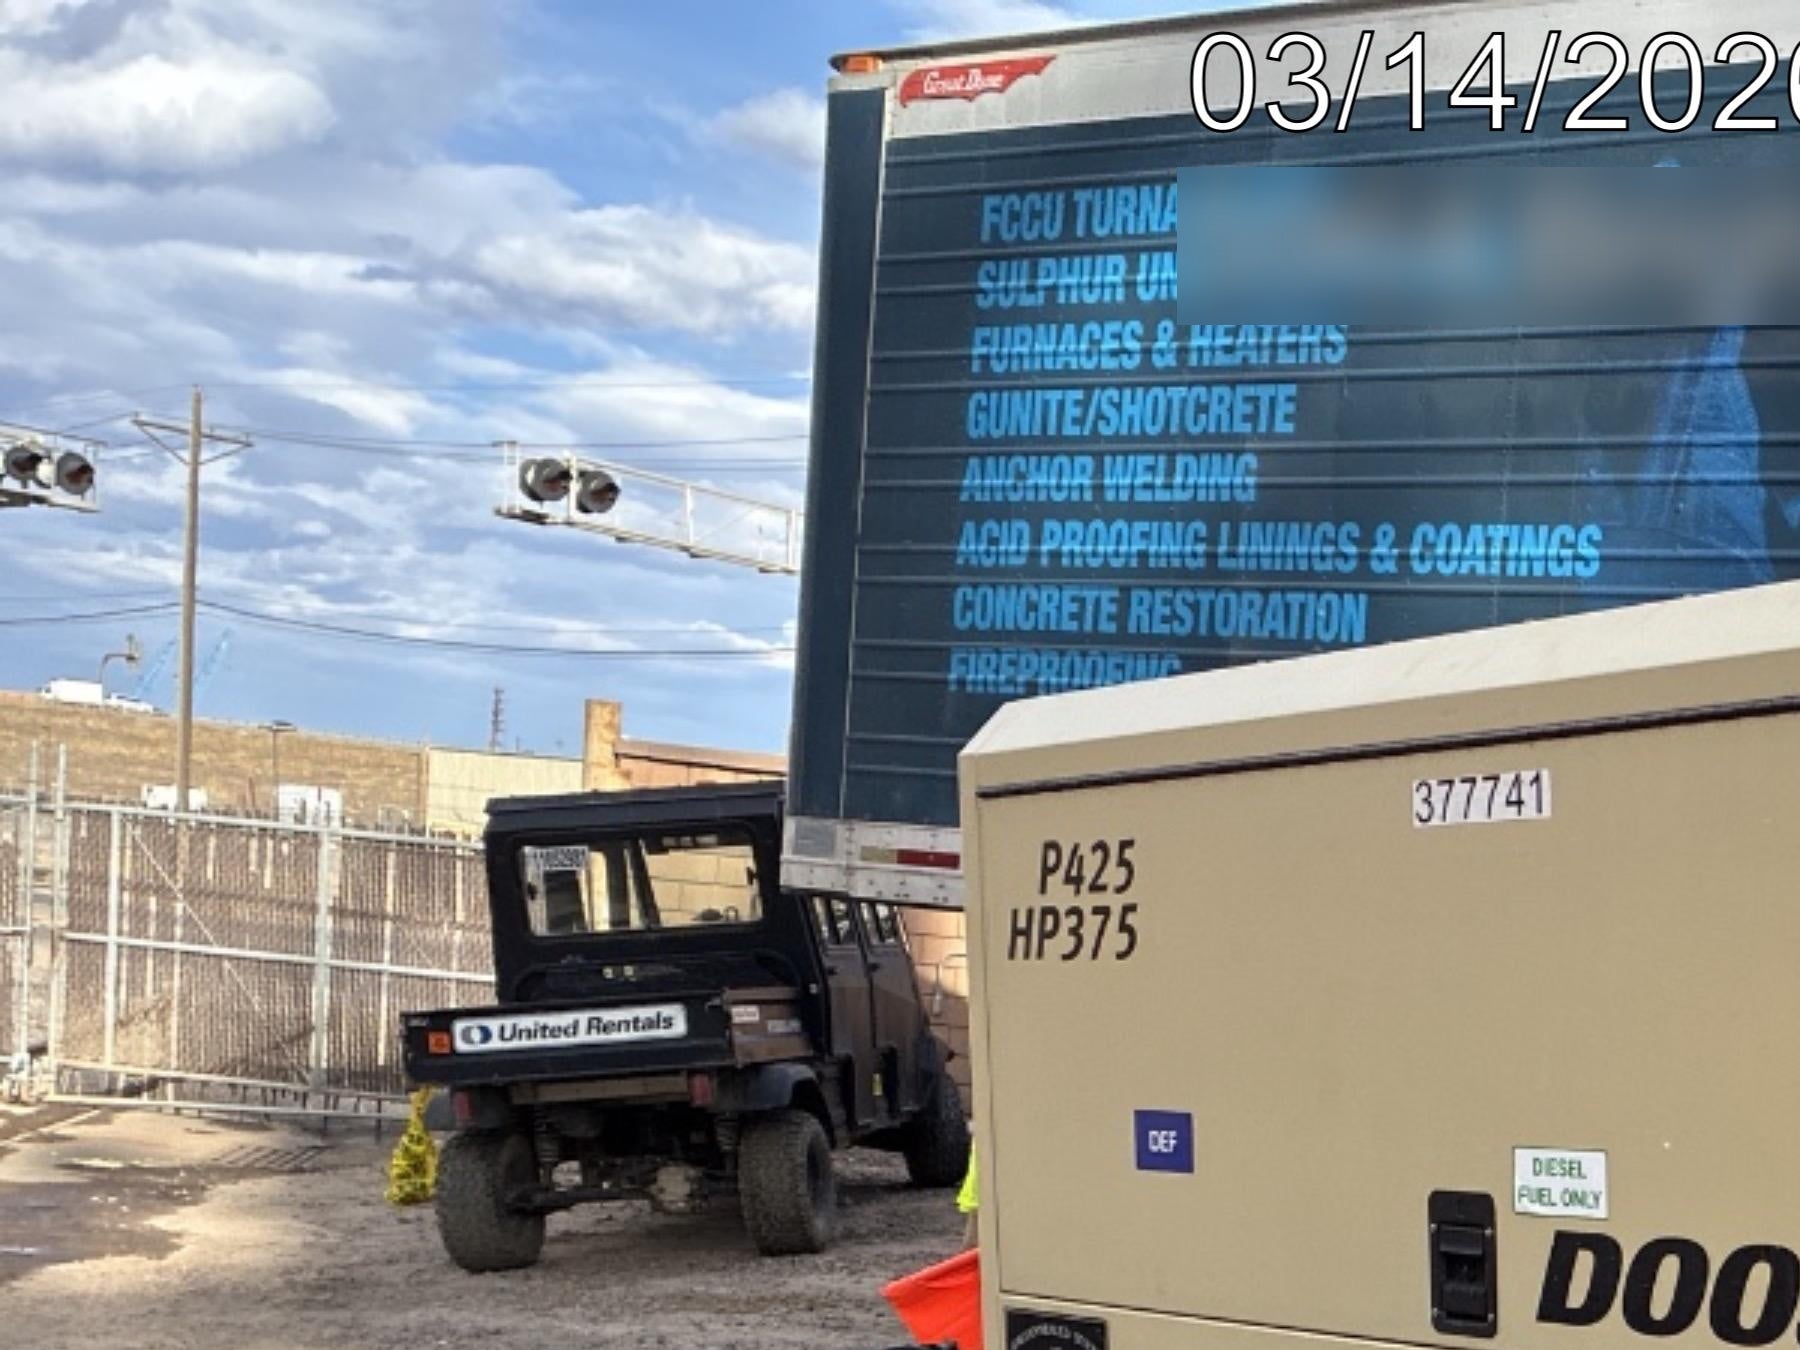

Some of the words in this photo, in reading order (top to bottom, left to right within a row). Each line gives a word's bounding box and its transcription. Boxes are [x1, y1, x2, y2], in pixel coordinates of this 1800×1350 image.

[980, 192, 1065, 243] FCCU
[975, 254, 1126, 309] SULPHUR
[970, 320, 1143, 374] FURNACES
[1151, 319, 1178, 369] &
[1187, 325, 1348, 368] HEATERS
[965, 383, 1297, 439] GUNITE/SHOTCRETE
[959, 454, 1095, 502] ANCHOR
[1103, 453, 1257, 502] WELDING
[955, 519, 1031, 569] ACID
[1040, 519, 1207, 569] PROOFING
[1217, 521, 1361, 574] LININGS
[1370, 522, 1399, 575] &
[1409, 523, 1603, 578] COATINGS
[952, 584, 1121, 633] CONCRETE
[1127, 587, 1370, 643] RESTORATION
[1416, 769, 1544, 824] 377741
[1039, 838, 1135, 896] P425
[1008, 903, 1138, 961] HP375
[500, 1016, 578, 1043] United
[585, 1010, 674, 1037] Rentals
[1148, 1130, 1177, 1153] DEF
[1532, 1157, 1588, 1180] DIESEL
[1518, 1185, 1557, 1206] FUEL
[1560, 1187, 1603, 1209] ONLY
